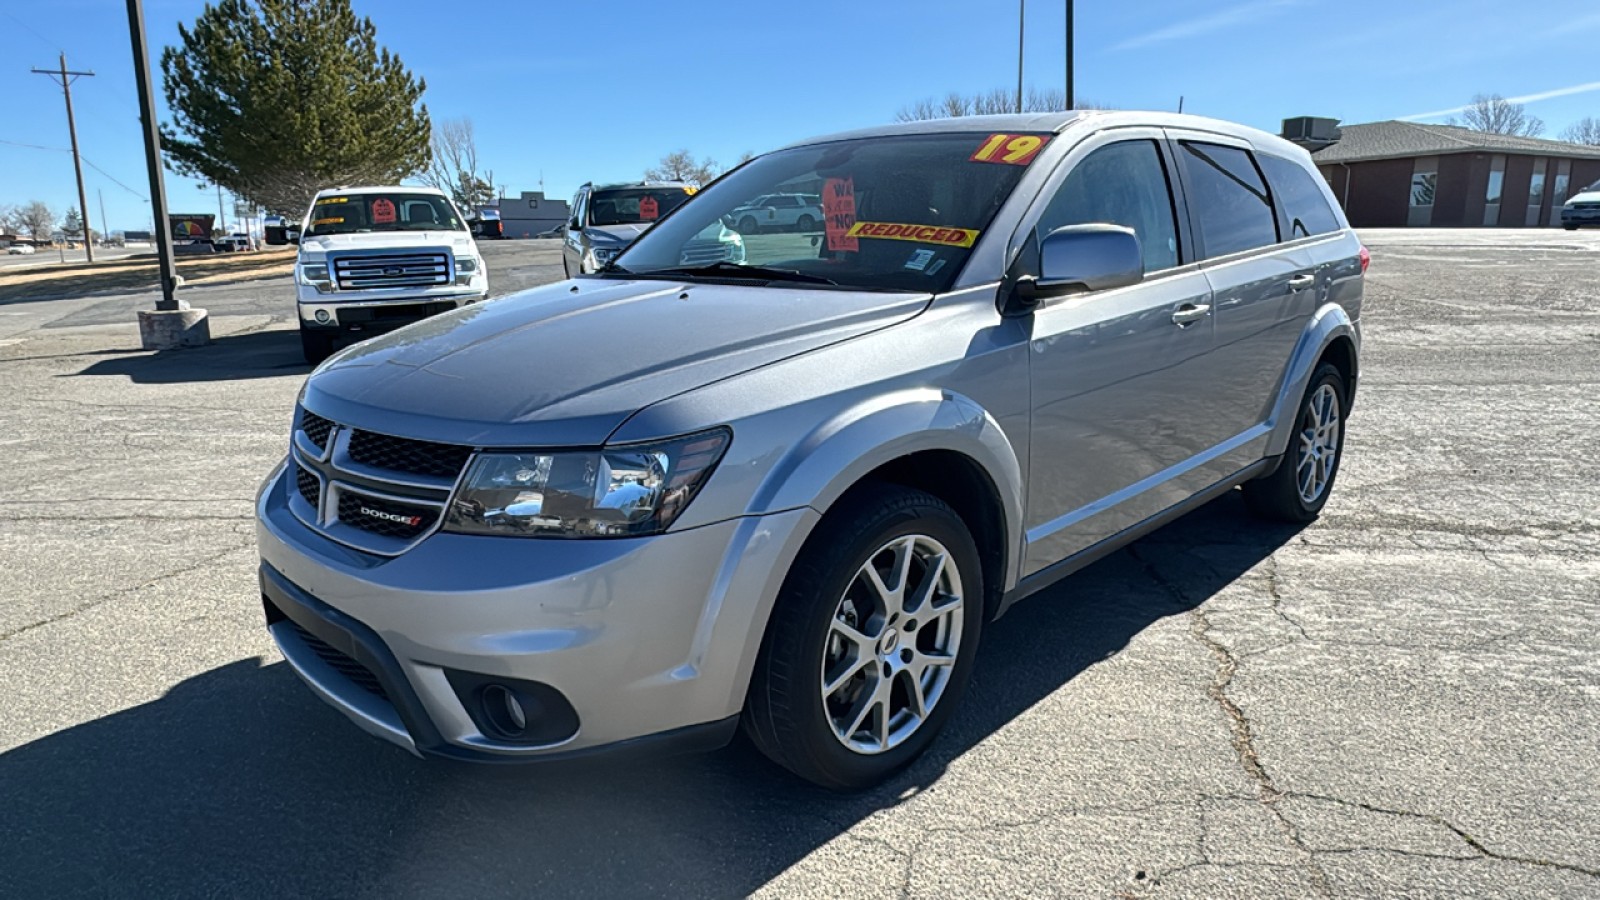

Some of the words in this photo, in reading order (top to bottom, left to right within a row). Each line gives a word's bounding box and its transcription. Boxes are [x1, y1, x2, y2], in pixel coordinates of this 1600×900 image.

[974, 134, 1041, 163] 19
[855, 223, 967, 242] REDUCED
[361, 506, 411, 525] DODGE
